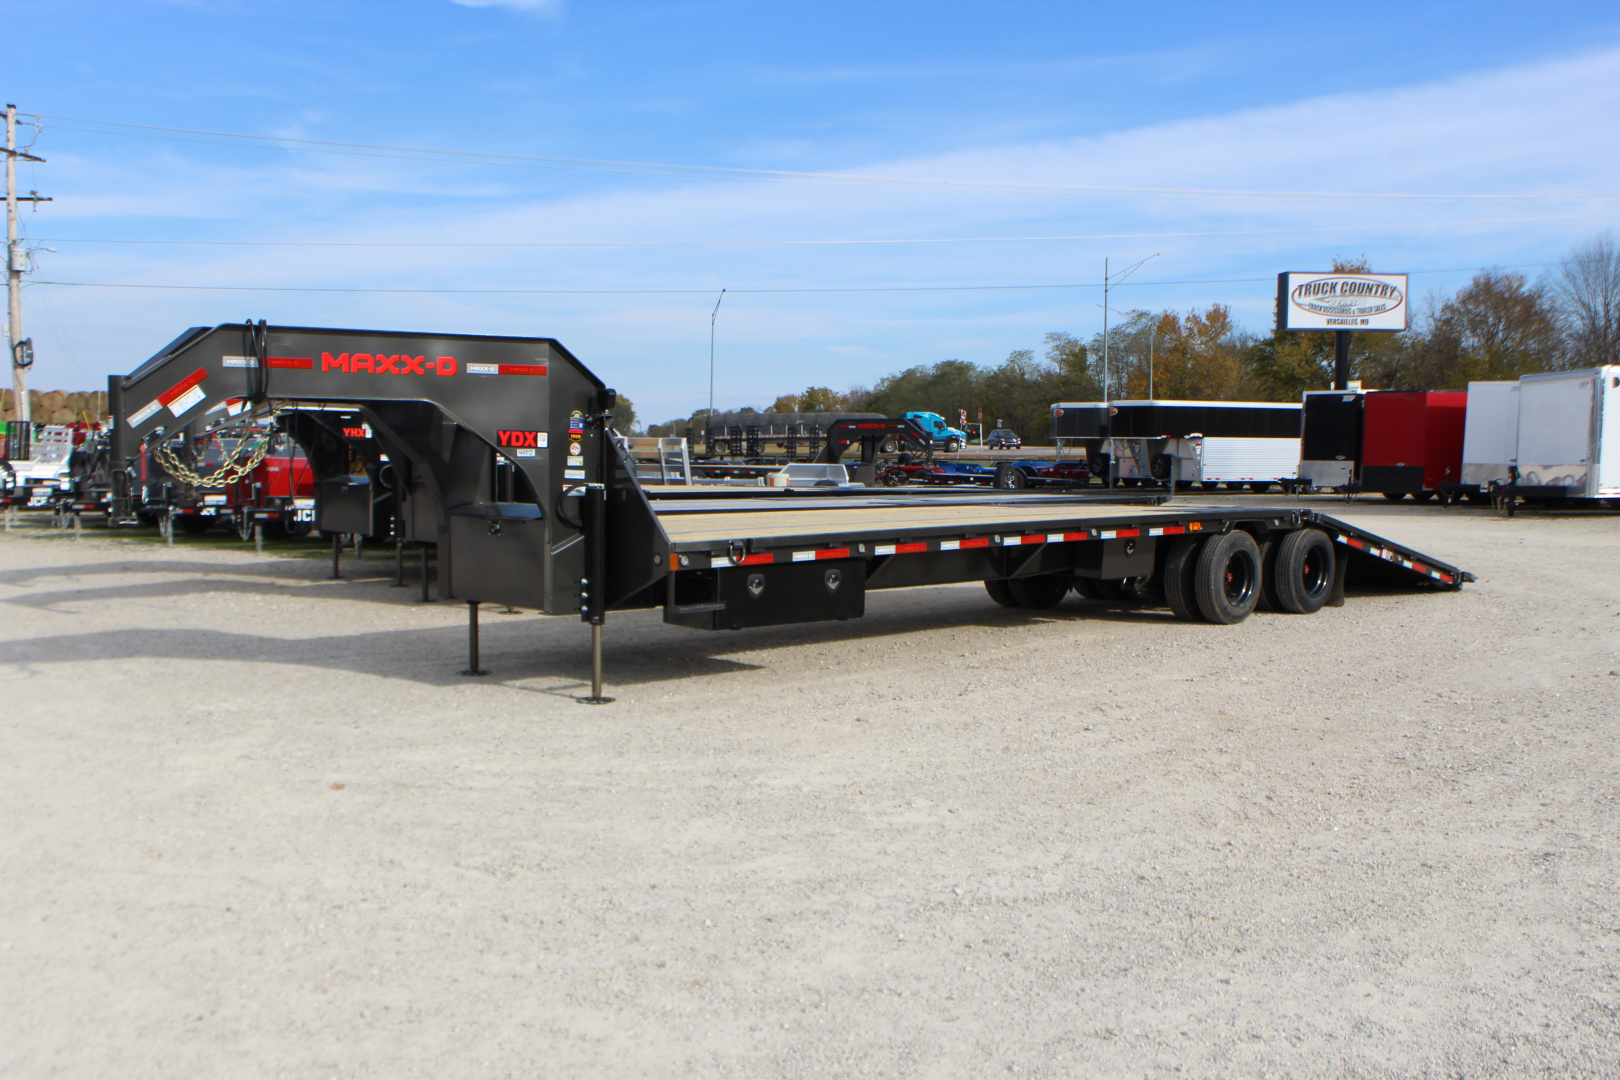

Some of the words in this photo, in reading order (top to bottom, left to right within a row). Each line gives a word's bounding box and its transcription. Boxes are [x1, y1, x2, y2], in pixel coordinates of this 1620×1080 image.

[1297, 281, 1338, 298] TRUCK
[1340, 281, 1397, 298] COUNTRY
[1308, 302, 1322, 312] TRUCK
[1322, 305, 1352, 315] ACCESSORIES
[1356, 305, 1373, 315] TRAILER
[1373, 303, 1386, 312] SALES
[1360, 318, 1369, 326] MO
[321, 352, 458, 376] MAXX-D
[343, 428, 365, 437] YHX
[497, 430, 537, 447] YDX
